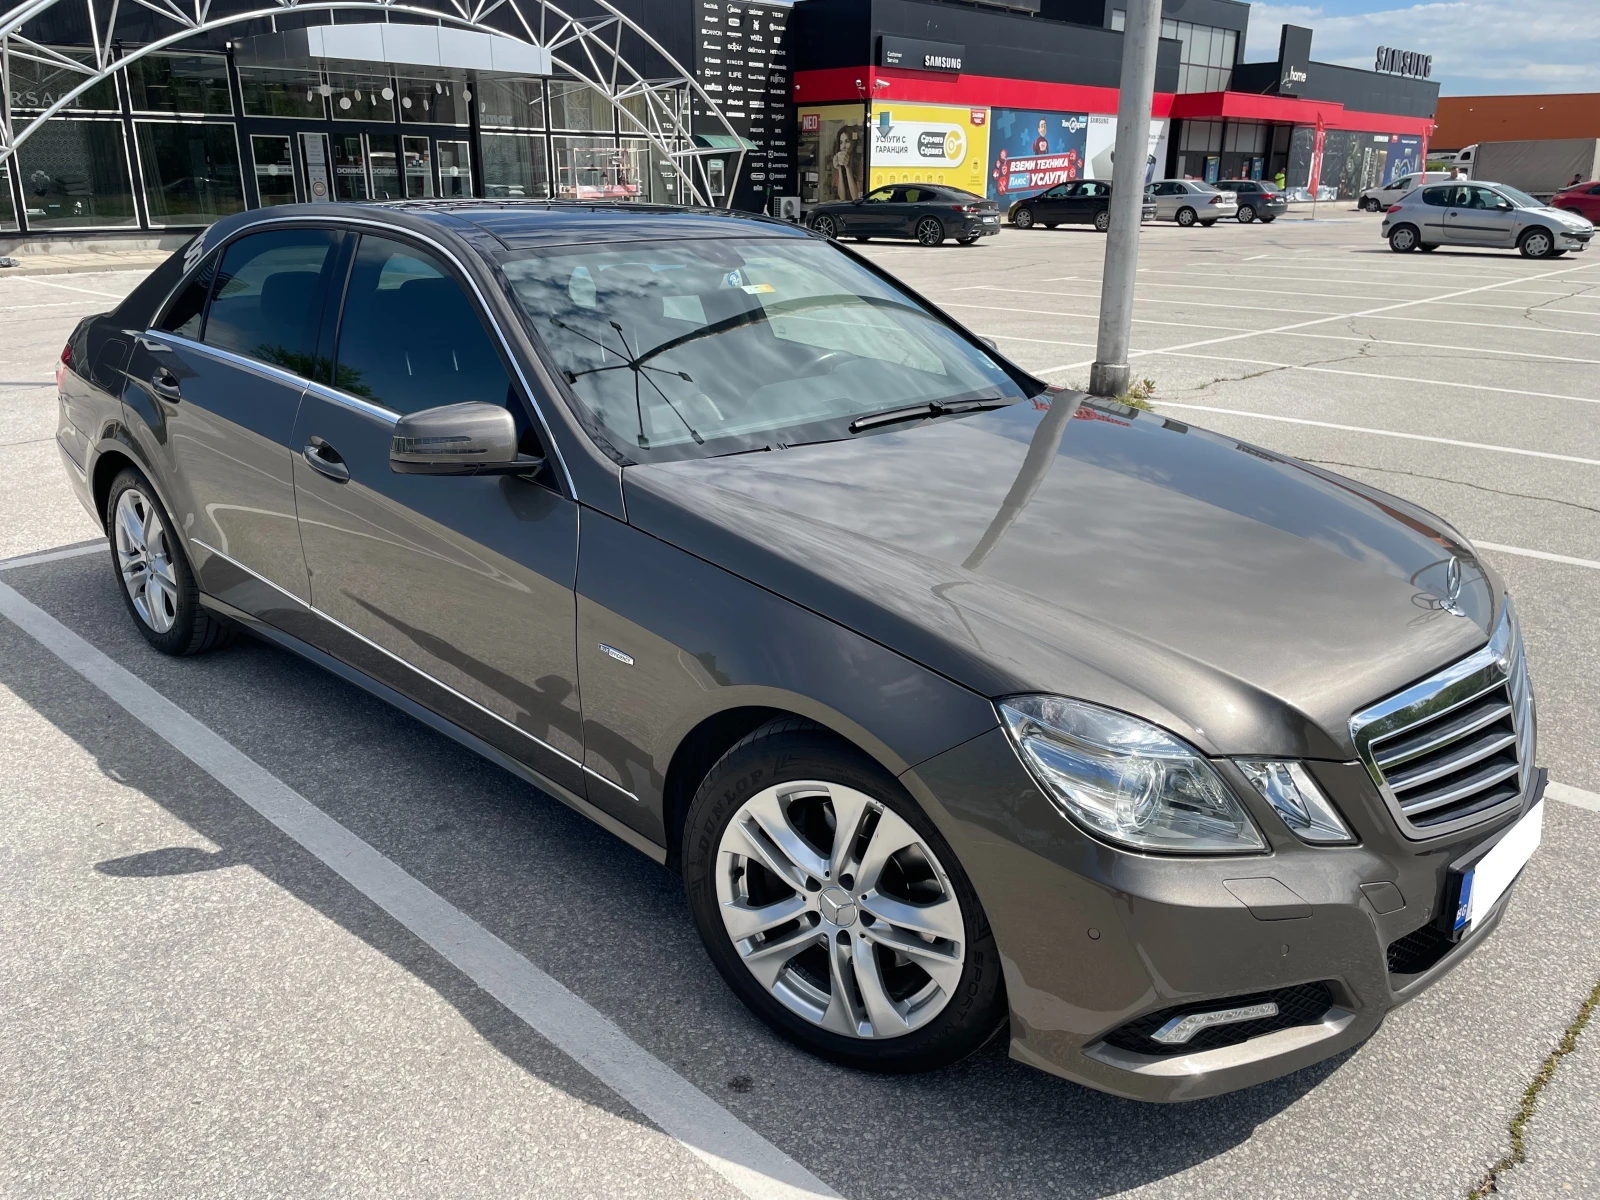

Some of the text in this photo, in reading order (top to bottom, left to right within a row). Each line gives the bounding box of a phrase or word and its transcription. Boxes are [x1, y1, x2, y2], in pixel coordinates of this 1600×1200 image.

[924, 54, 962, 69] SAMSUNG
[1376, 46, 1433, 78] SAMSUNG
[770, 73, 785, 84] FUJITSU
[1289, 65, 1307, 83] home
[728, 83, 743, 92] dyson
[803, 116, 818, 130] NEO
[875, 135, 901, 143] УСЛУГИ
[920, 134, 944, 145] Сръчко
[875, 146, 908, 154] ГАРАНЦИЯ
[920, 147, 943, 156] Сервиз
[1010, 157, 1068, 171] ВЗЕМИ ТЕХНИКА
[1030, 170, 1068, 186] УСЛУГИ
[699, 768, 764, 855] DUNLOP
[957, 949, 984, 1022] SPORT
